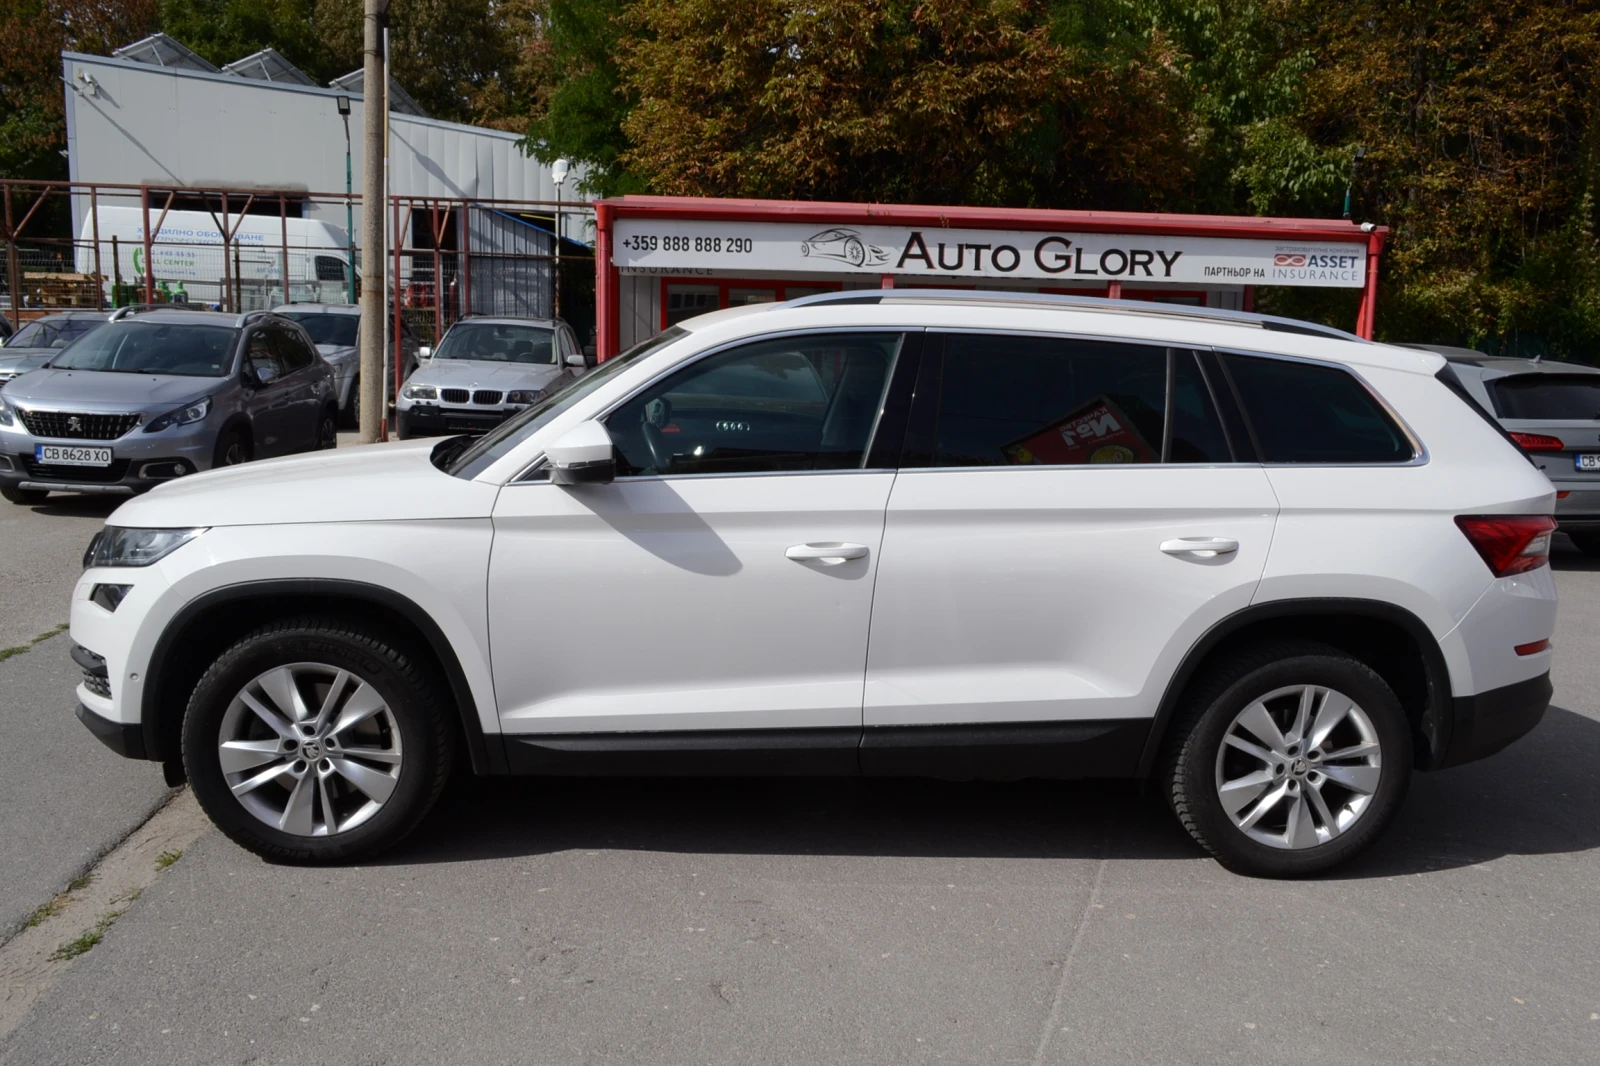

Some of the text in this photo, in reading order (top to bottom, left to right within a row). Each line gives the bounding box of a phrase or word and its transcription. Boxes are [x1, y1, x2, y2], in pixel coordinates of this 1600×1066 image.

[196, 230, 265, 241] ОБОВАНЕ
[622, 235, 753, 253] +359 888 888 290
[1274, 245, 1328, 254] застрахователна
[896, 231, 1183, 277] AUTO GLORY
[1307, 254, 1359, 269] ASSET
[1204, 266, 1265, 278] ПАРТНЬОР НА
[1272, 268, 1358, 281] INSURANCE
[44, 447, 60, 460] CB
[62, 448, 91, 461] 8628
